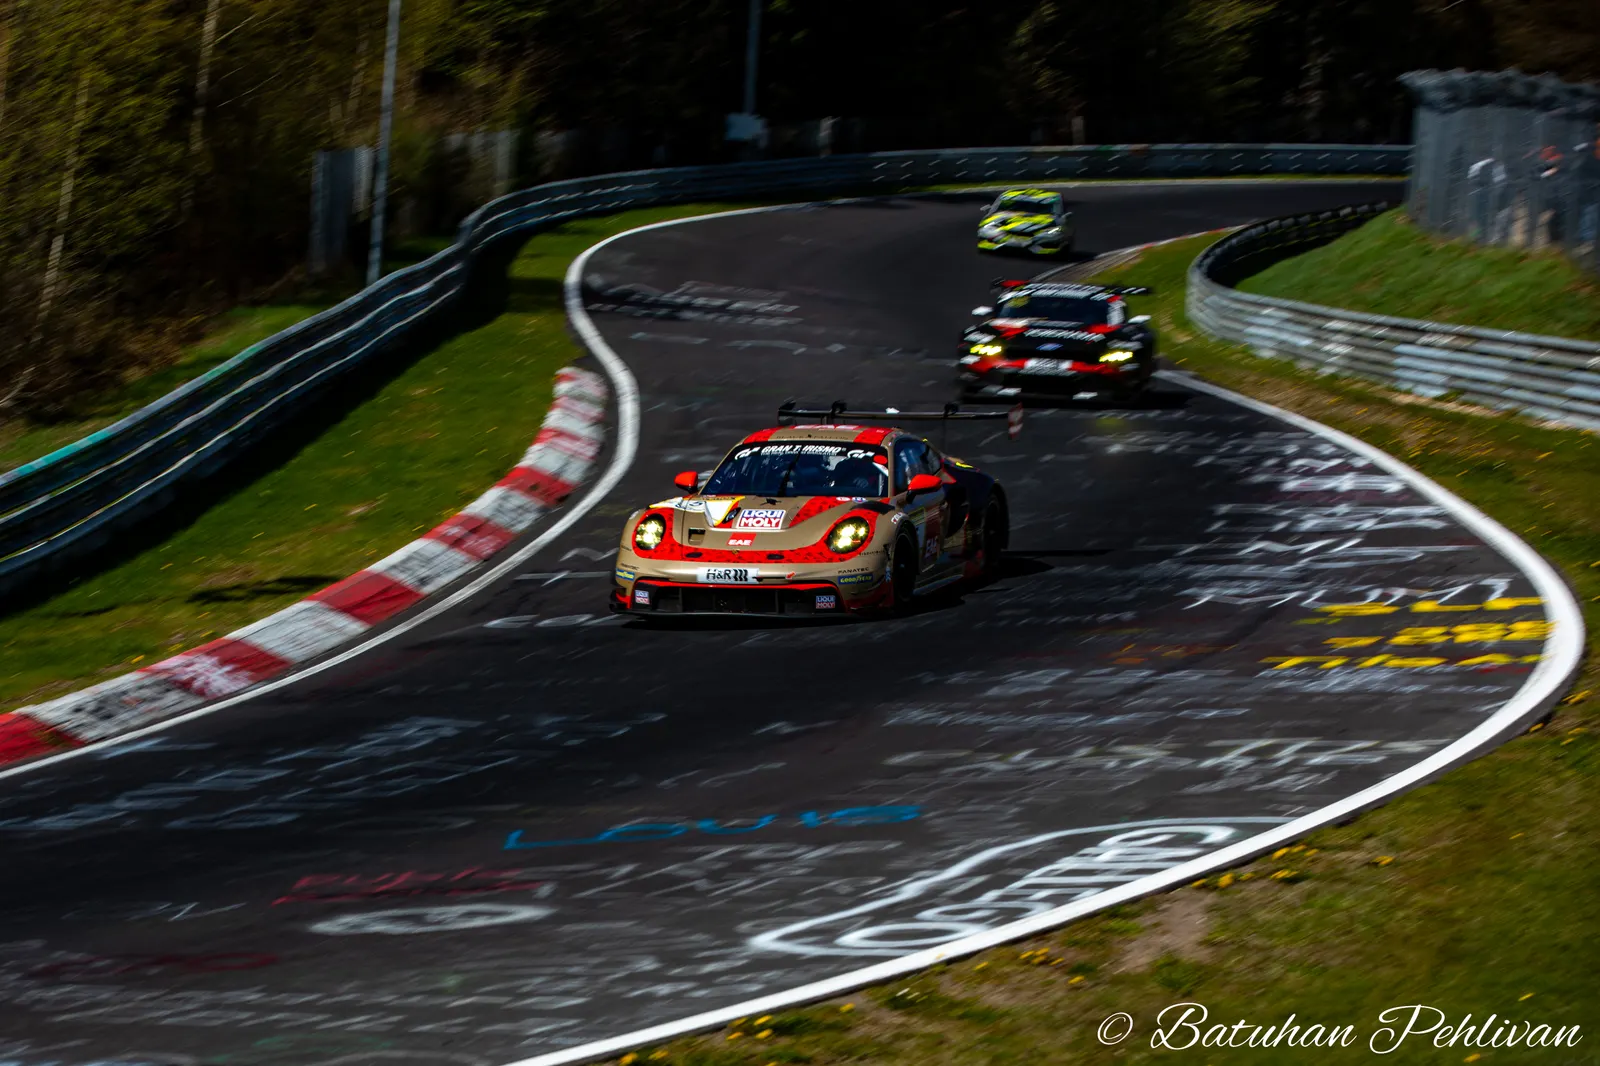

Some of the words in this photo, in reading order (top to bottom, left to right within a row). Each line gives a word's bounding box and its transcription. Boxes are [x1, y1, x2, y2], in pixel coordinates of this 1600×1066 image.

[761, 445, 794, 453] GRAN
[743, 510, 782, 518] LIQUI
[740, 518, 780, 528] MOLY
[837, 566, 870, 574] FANATEC
[706, 569, 732, 581] H&R
[840, 574, 873, 583] GOODYEAR
